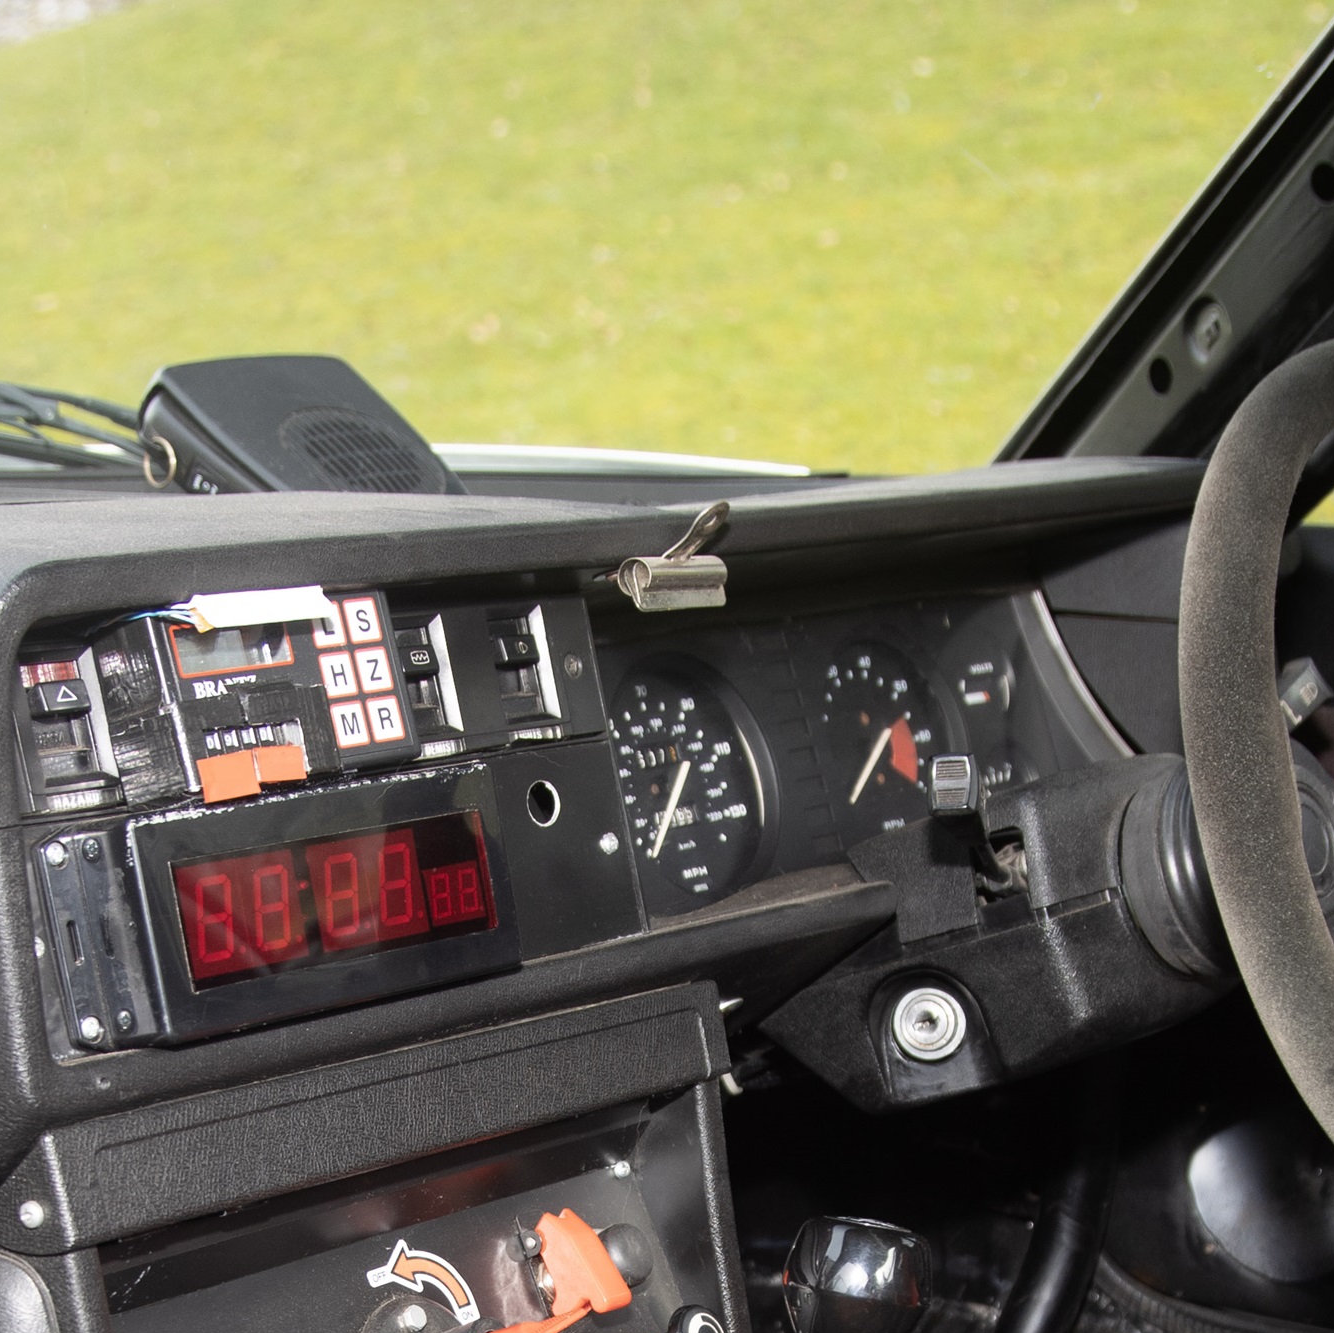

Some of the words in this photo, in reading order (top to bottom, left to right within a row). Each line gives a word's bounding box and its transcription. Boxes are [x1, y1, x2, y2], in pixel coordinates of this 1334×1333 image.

[355, 609, 371, 632] S
[331, 664, 348, 687] H
[366, 658, 382, 682] Z
[341, 712, 360, 736] M
[378, 707, 394, 730] R
[682, 865, 709, 880] MPH
[371, 1270, 387, 1283] OFF
[461, 1311, 474, 1321] ON
